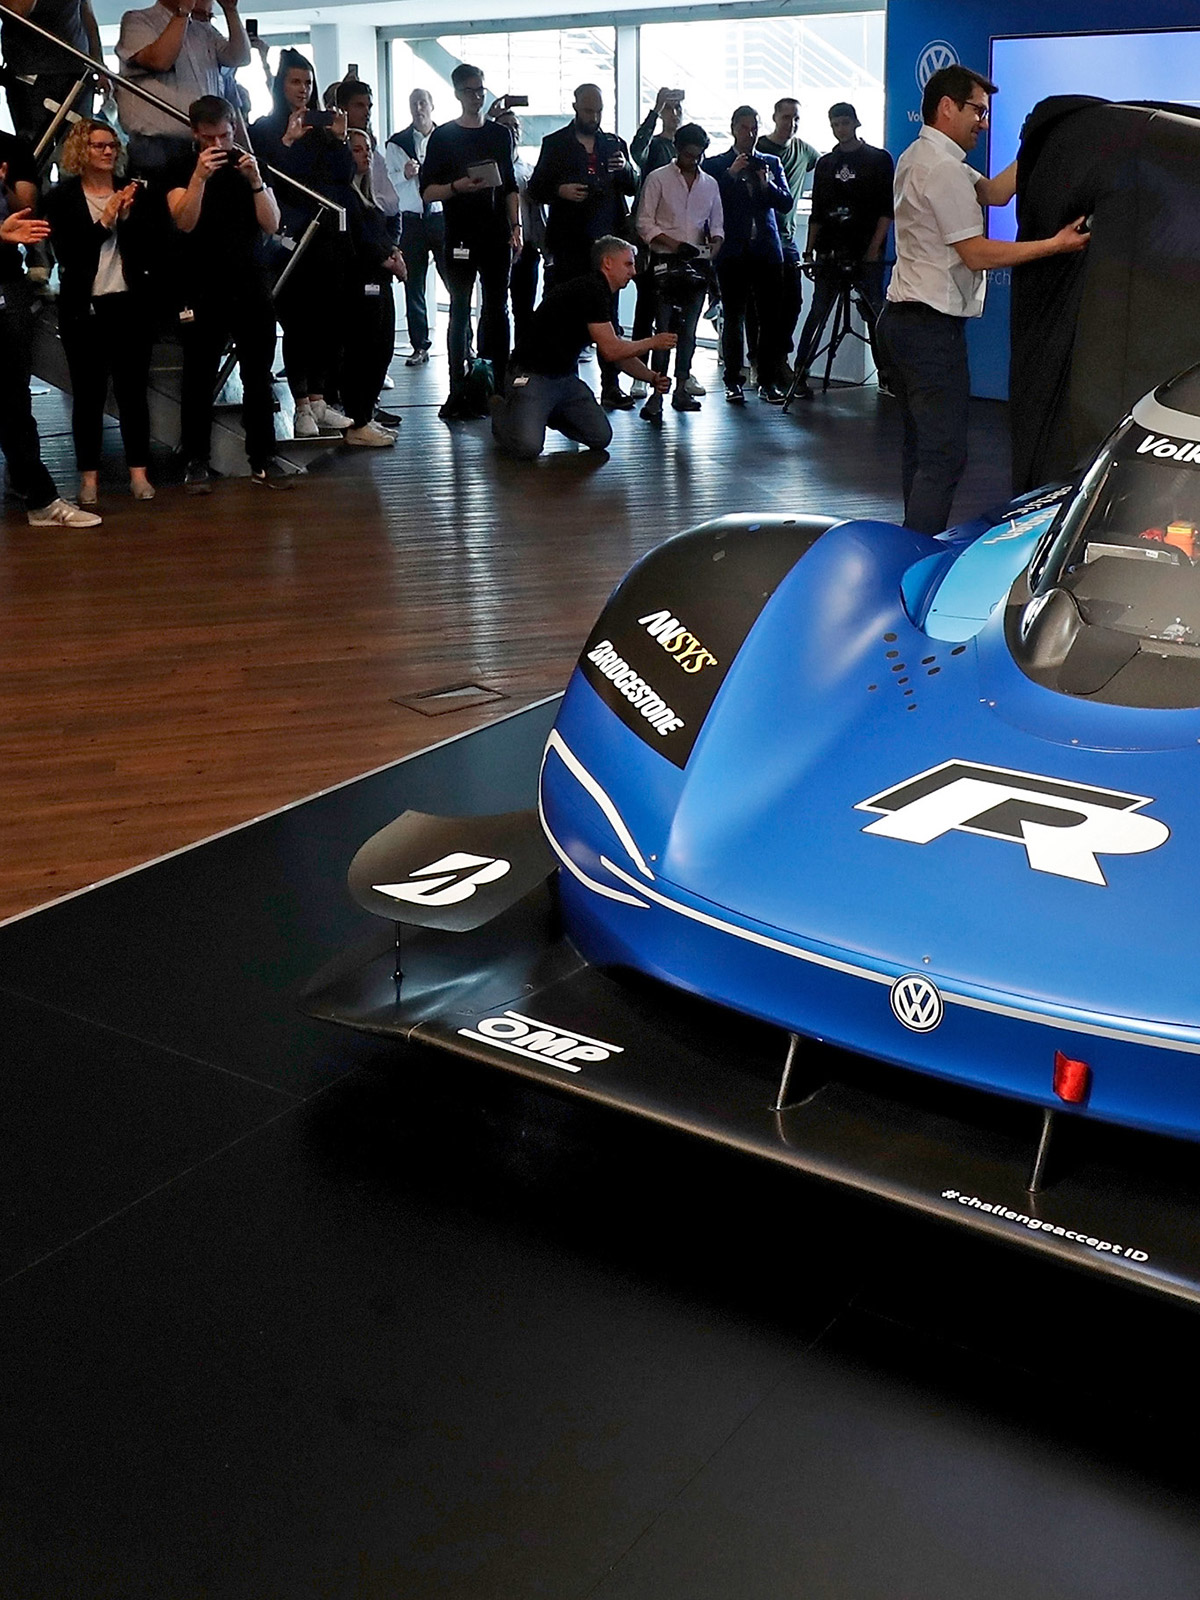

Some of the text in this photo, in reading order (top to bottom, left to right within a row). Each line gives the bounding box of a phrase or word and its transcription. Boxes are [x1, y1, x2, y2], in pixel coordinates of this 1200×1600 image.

[637, 610, 718, 674] ANSYS
[587, 640, 686, 736] BRIDGESTONE
[852, 758, 1171, 887] R
[476, 1016, 612, 1063] OMP
[1123, 1248, 1149, 1262] ID
